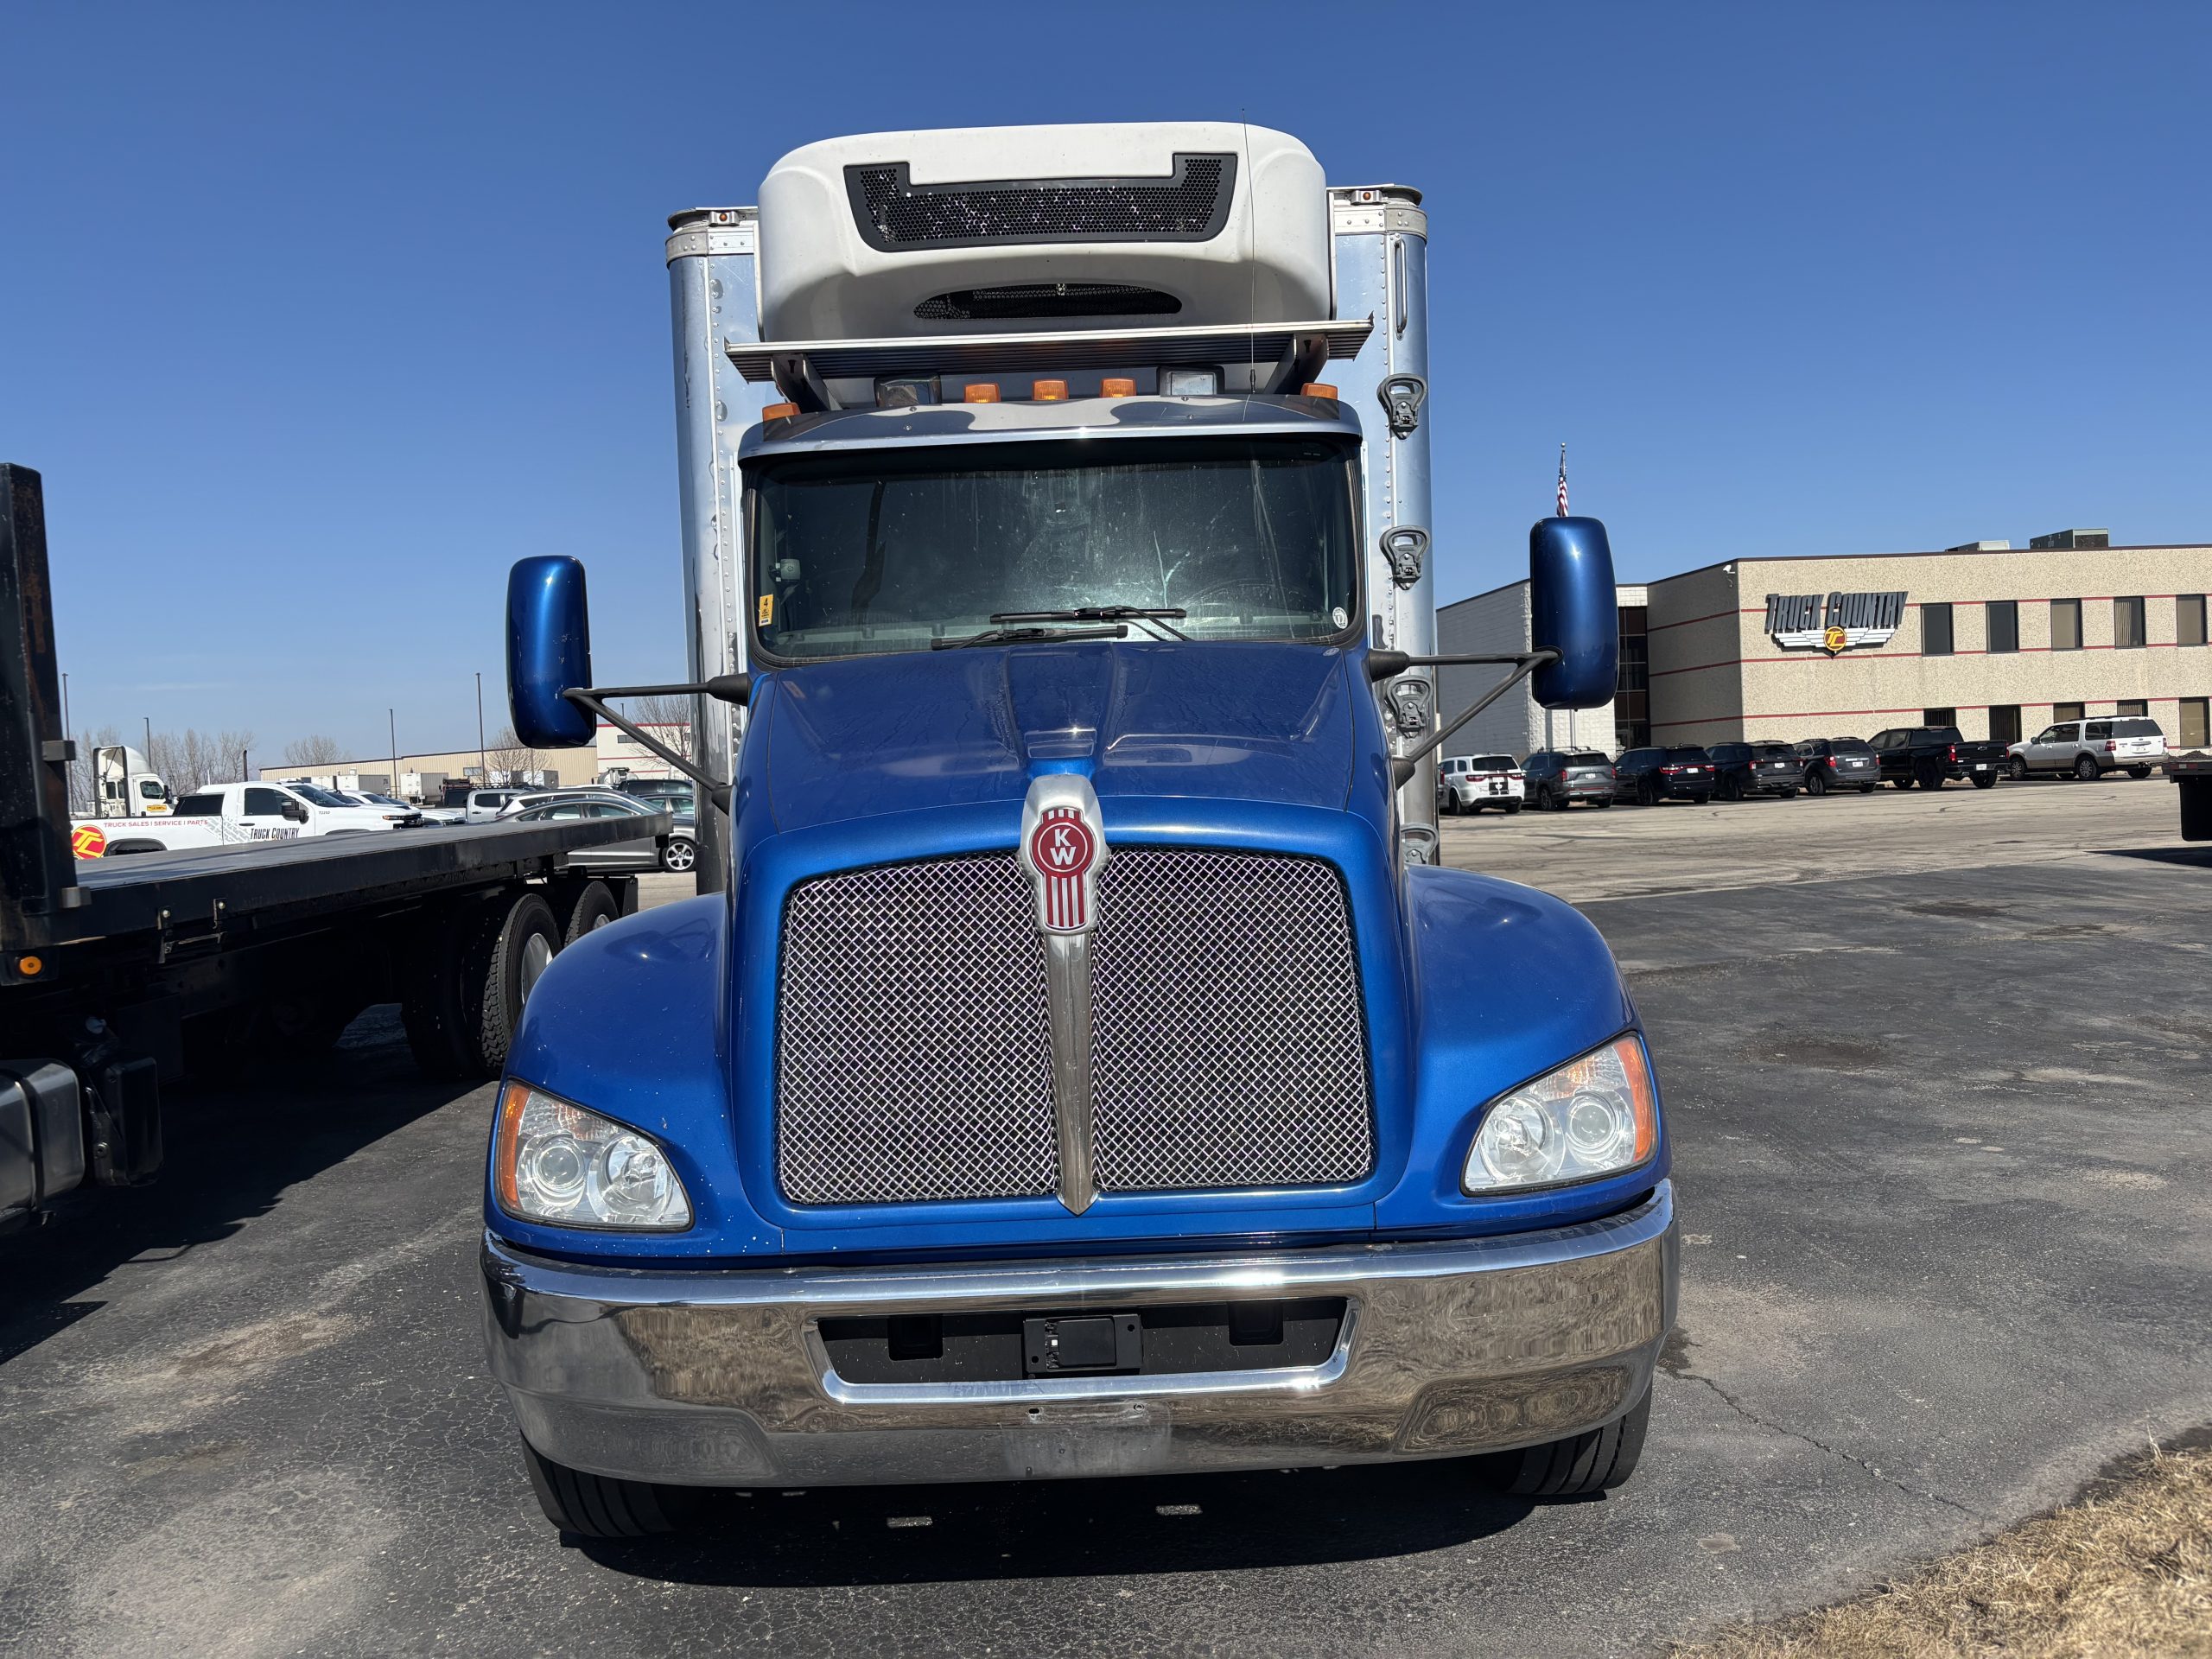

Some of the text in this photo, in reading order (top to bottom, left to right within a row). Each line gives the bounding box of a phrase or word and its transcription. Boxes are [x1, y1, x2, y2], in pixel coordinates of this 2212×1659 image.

[1765, 591, 1909, 631] TRUCK COUNTRY
[1826, 631, 1846, 648] TC
[250, 827, 300, 839] TRUCK COUNTRY
[1054, 829, 1071, 847] K
[1049, 846, 1077, 865] W
